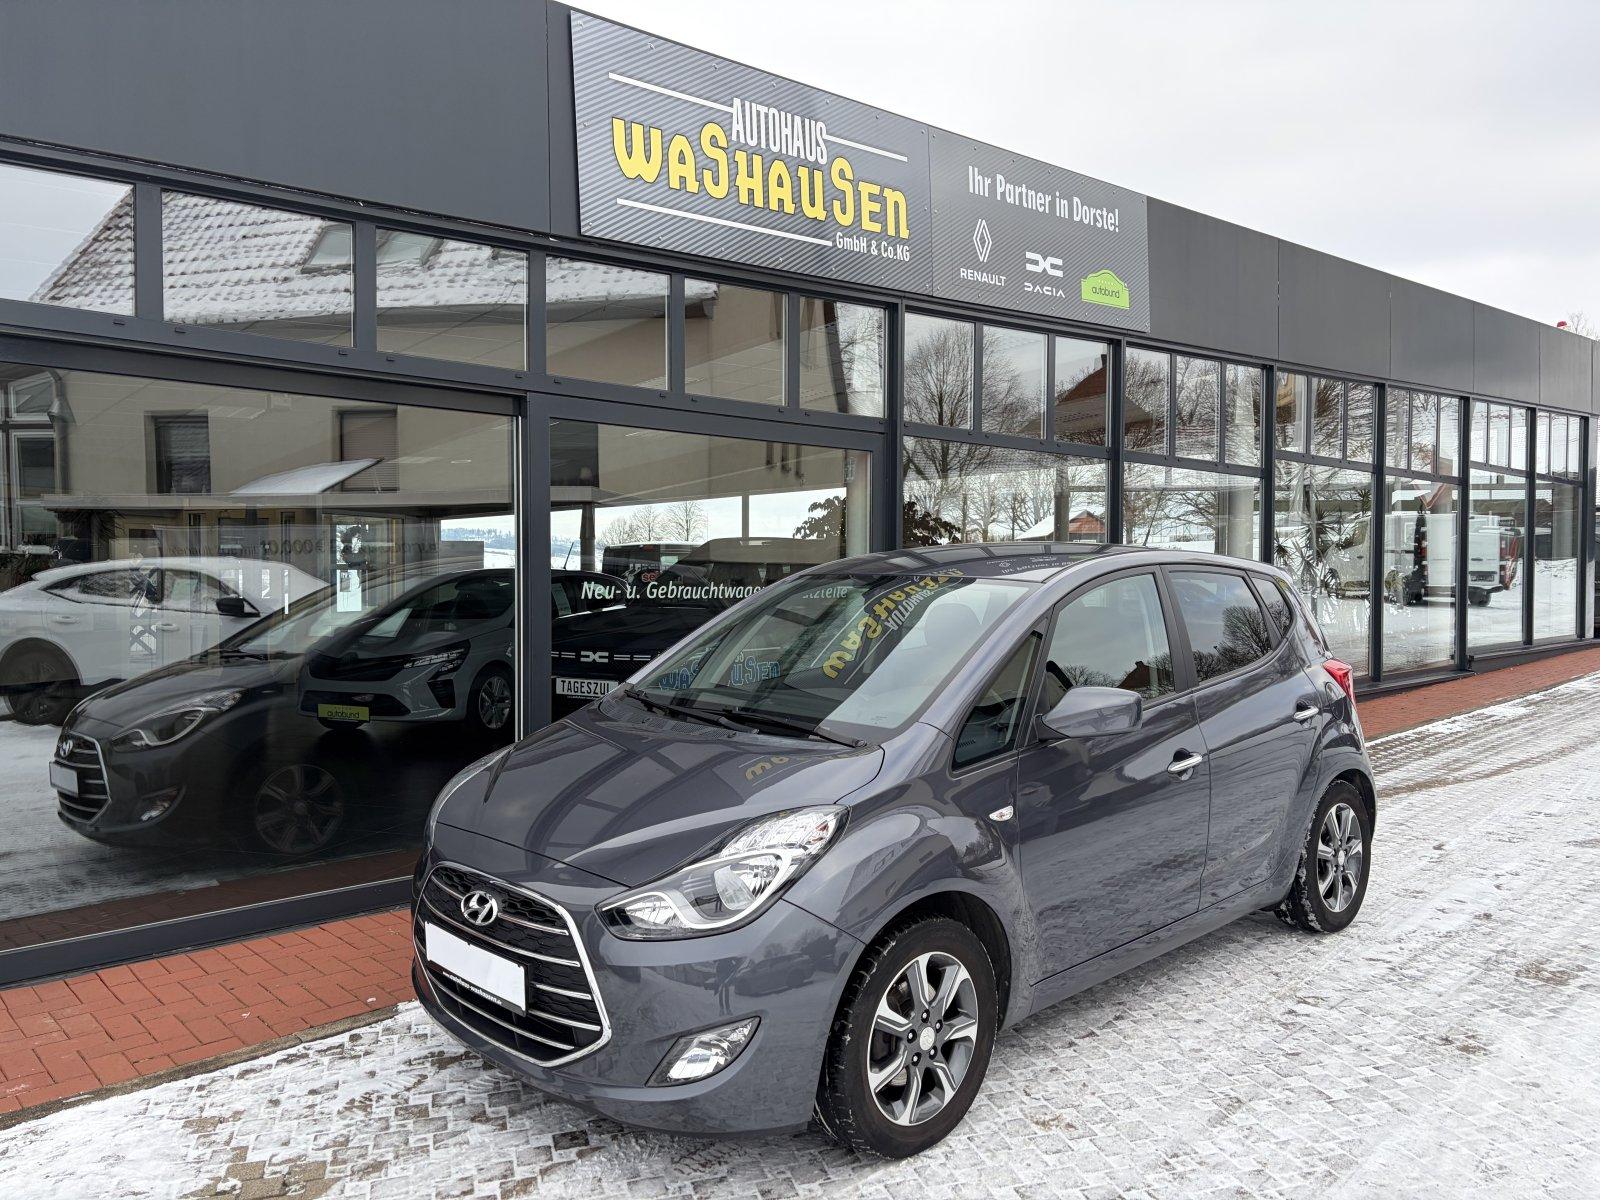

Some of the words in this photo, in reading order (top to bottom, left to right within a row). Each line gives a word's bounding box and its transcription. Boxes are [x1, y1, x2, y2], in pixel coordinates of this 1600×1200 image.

[730, 97, 828, 165] AUTOHAUS
[968, 165, 992, 198] Ihr
[996, 173, 1052, 214] Partner
[1055, 190, 1069, 219] in
[1073, 196, 1119, 233] Dorste!
[836, 231, 867, 254] GmbH
[870, 240, 879, 256] &
[881, 240, 910, 262] Co.KG
[960, 267, 1006, 287] RENAULT
[1024, 282, 1066, 299] DACIA
[1091, 286, 1120, 299] autobund
[581, 581, 621, 600] Neu-
[626, 585, 640, 599] u.
[646, 580, 764, 600] Gebrauchtwage
